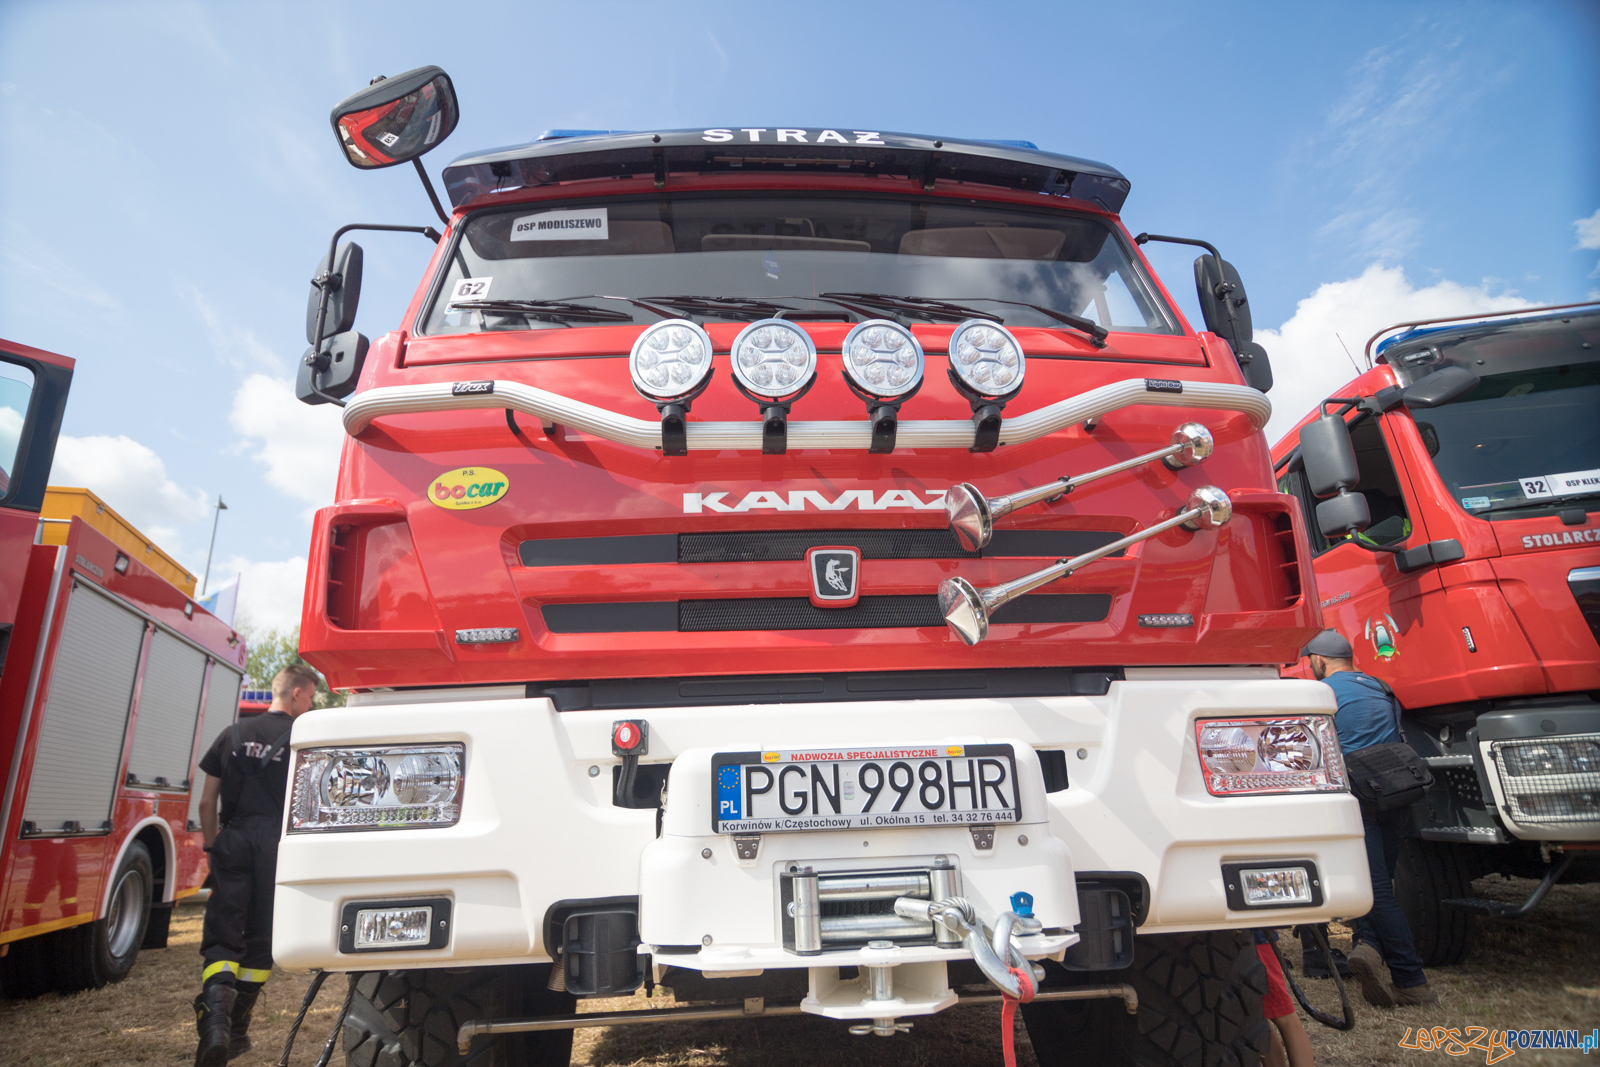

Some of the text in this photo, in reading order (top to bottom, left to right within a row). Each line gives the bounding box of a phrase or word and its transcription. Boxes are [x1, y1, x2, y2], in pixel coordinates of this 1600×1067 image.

[517, 218, 602, 232] OSP MODLISZEWO
[458, 282, 486, 296] 62
[454, 382, 493, 393] Trux
[434, 482, 505, 500] bocar
[1525, 480, 1547, 494] 32
[1565, 479, 1581, 487] OSP
[791, 752, 846, 761] NADWOZIA
[847, 749, 938, 760] SPECJALISTYCZNE
[720, 759, 1010, 817] PL PGN 998HR
[722, 812, 1013, 831] Korwinów k/Częstochowy ul. Okólna 15 tel. 34 32 76 444
